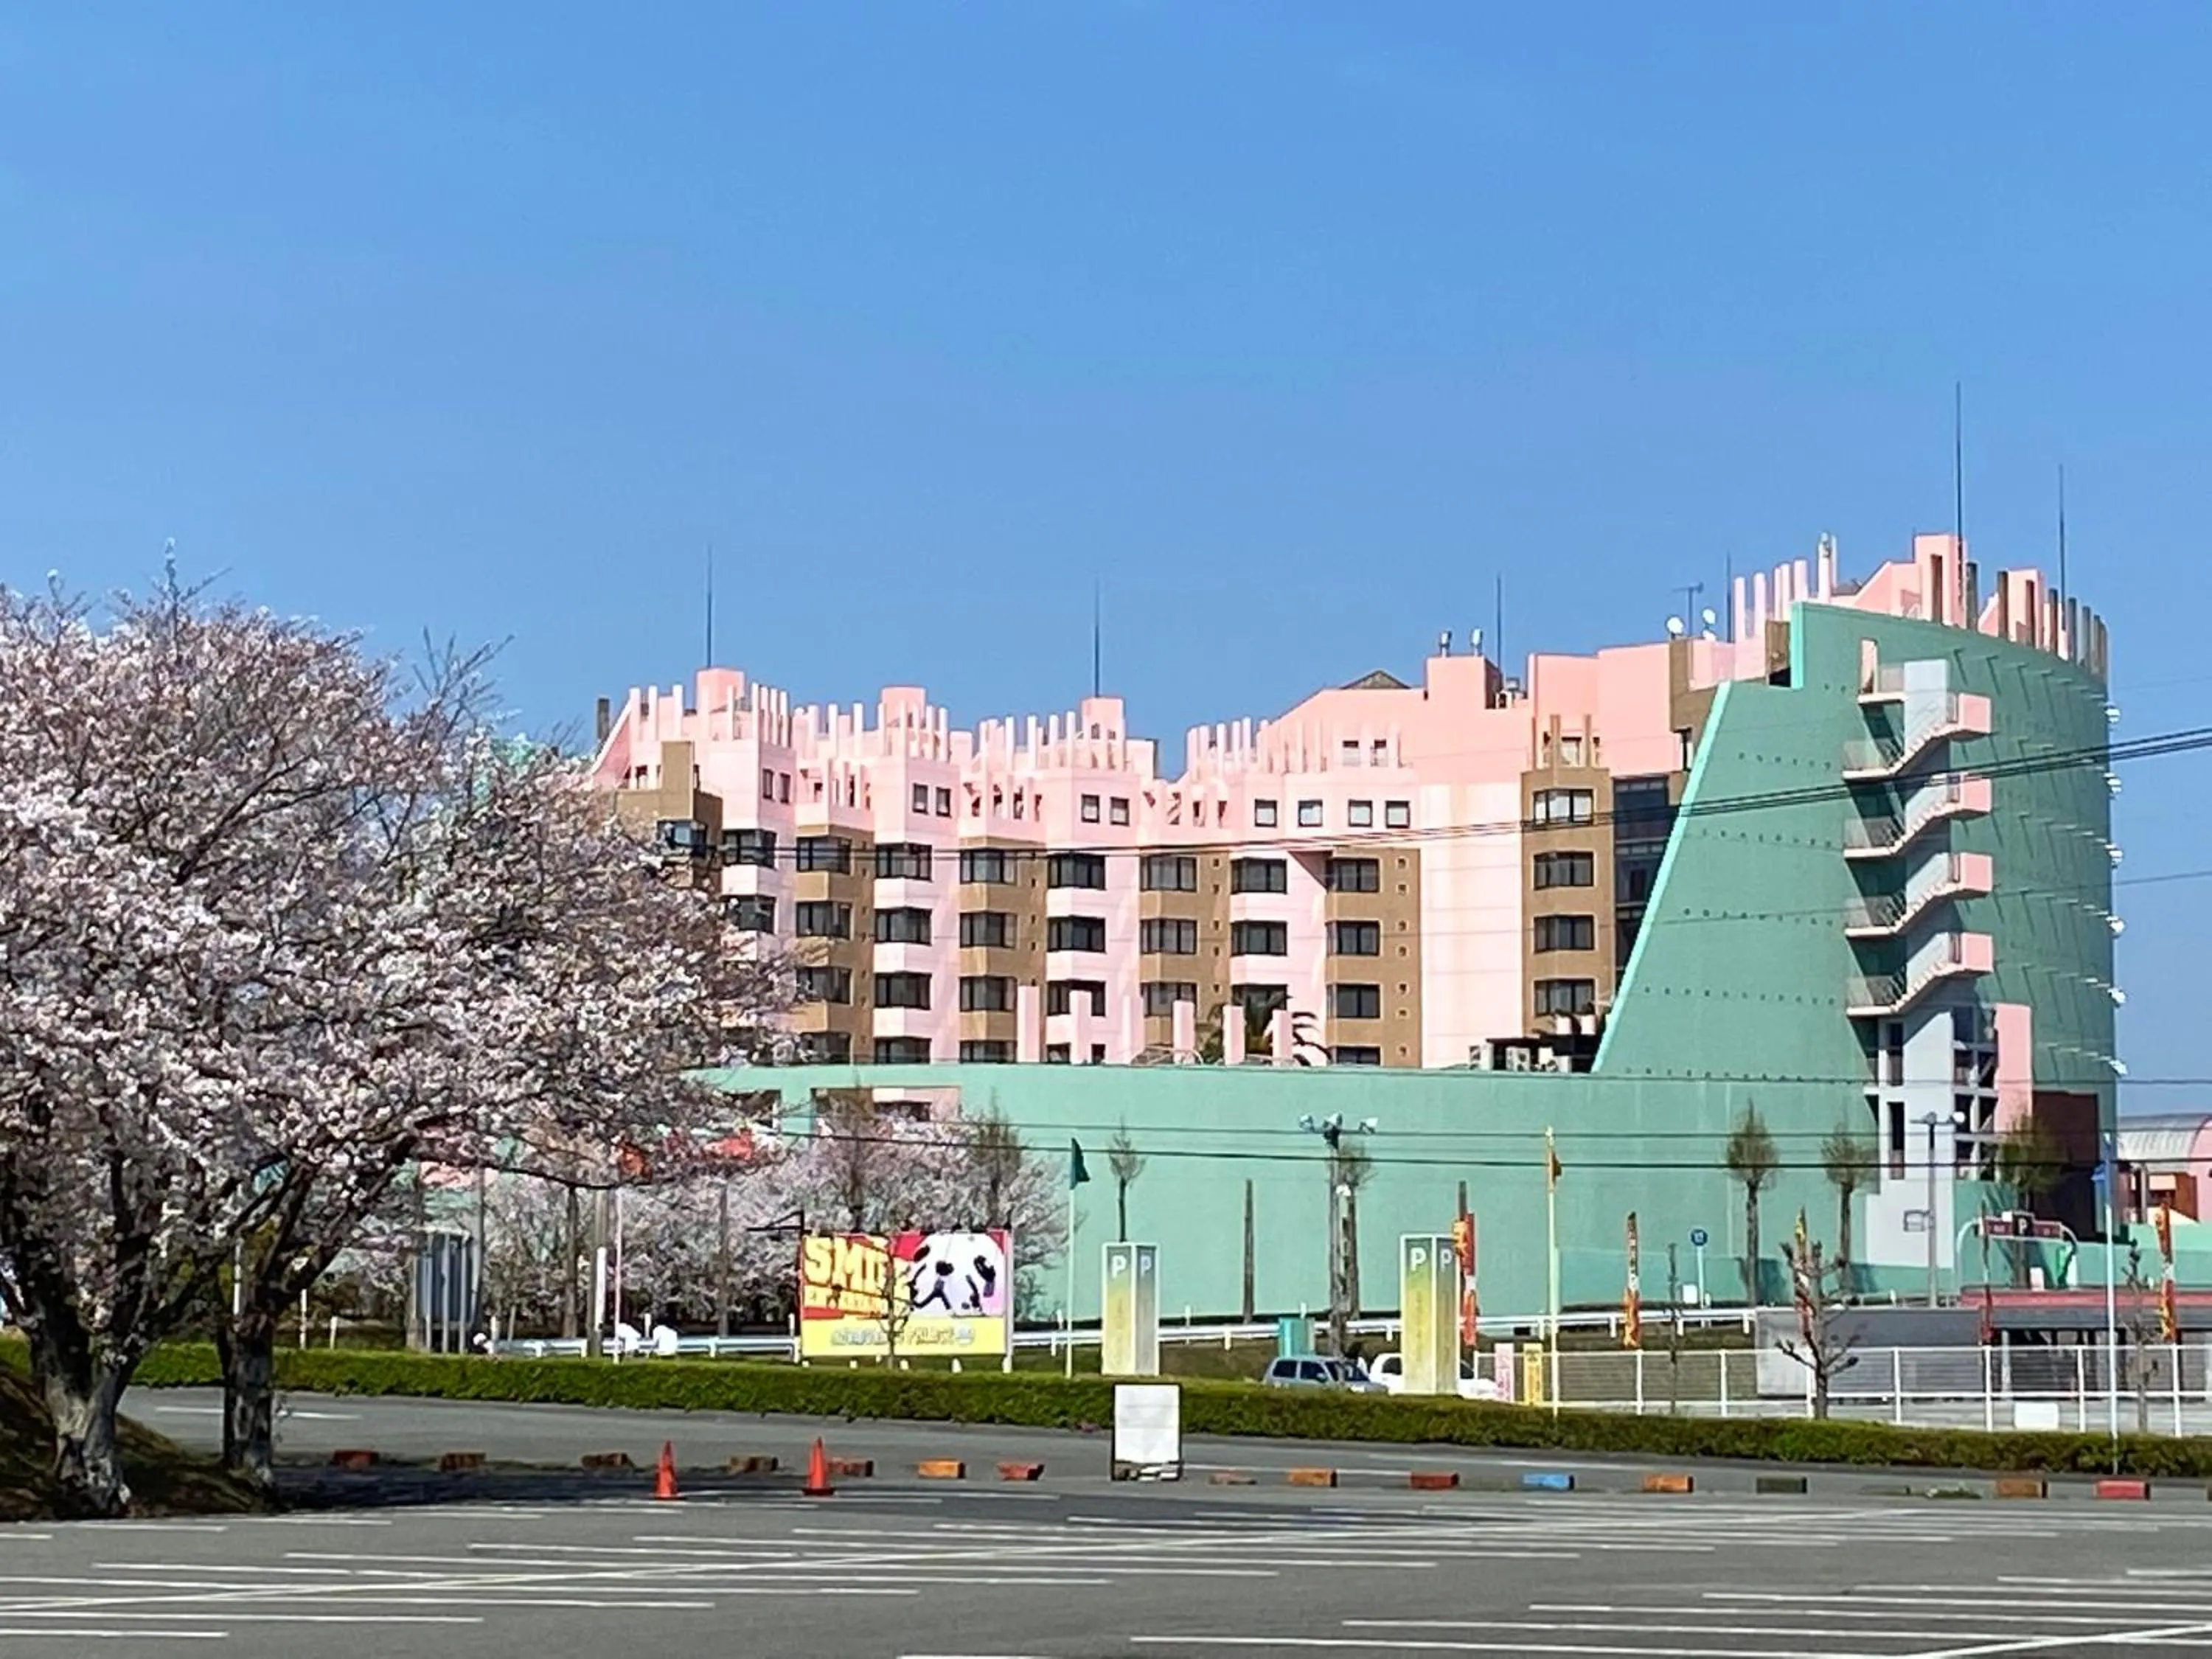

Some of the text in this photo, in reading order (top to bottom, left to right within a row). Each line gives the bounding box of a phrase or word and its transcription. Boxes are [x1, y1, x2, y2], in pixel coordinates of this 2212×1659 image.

[2018, 1218, 2028, 1234] P
[1113, 1255, 1127, 1279] P
[1141, 1255, 1152, 1278] P
[1411, 1247, 1426, 1272] P
[1440, 1248, 1453, 1273] P
